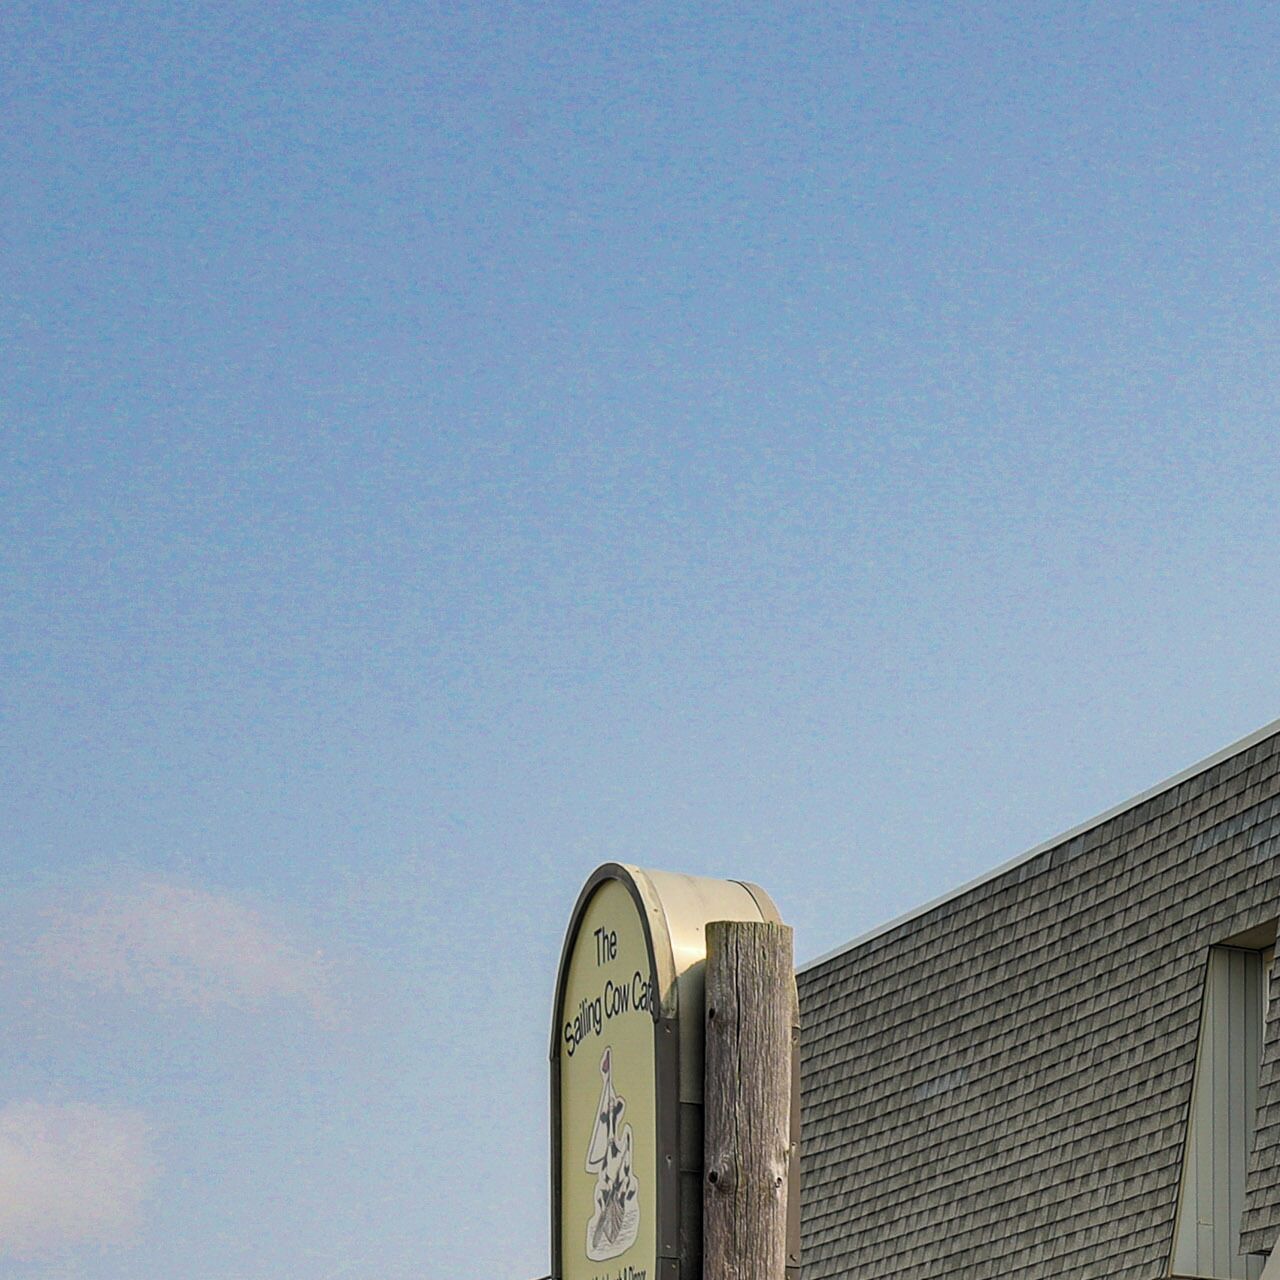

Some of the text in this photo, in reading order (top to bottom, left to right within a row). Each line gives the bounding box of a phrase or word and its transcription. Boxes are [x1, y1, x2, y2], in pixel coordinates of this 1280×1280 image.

[594, 925, 617, 967] The
[564, 970, 654, 1057] Sailing Cow Caf
